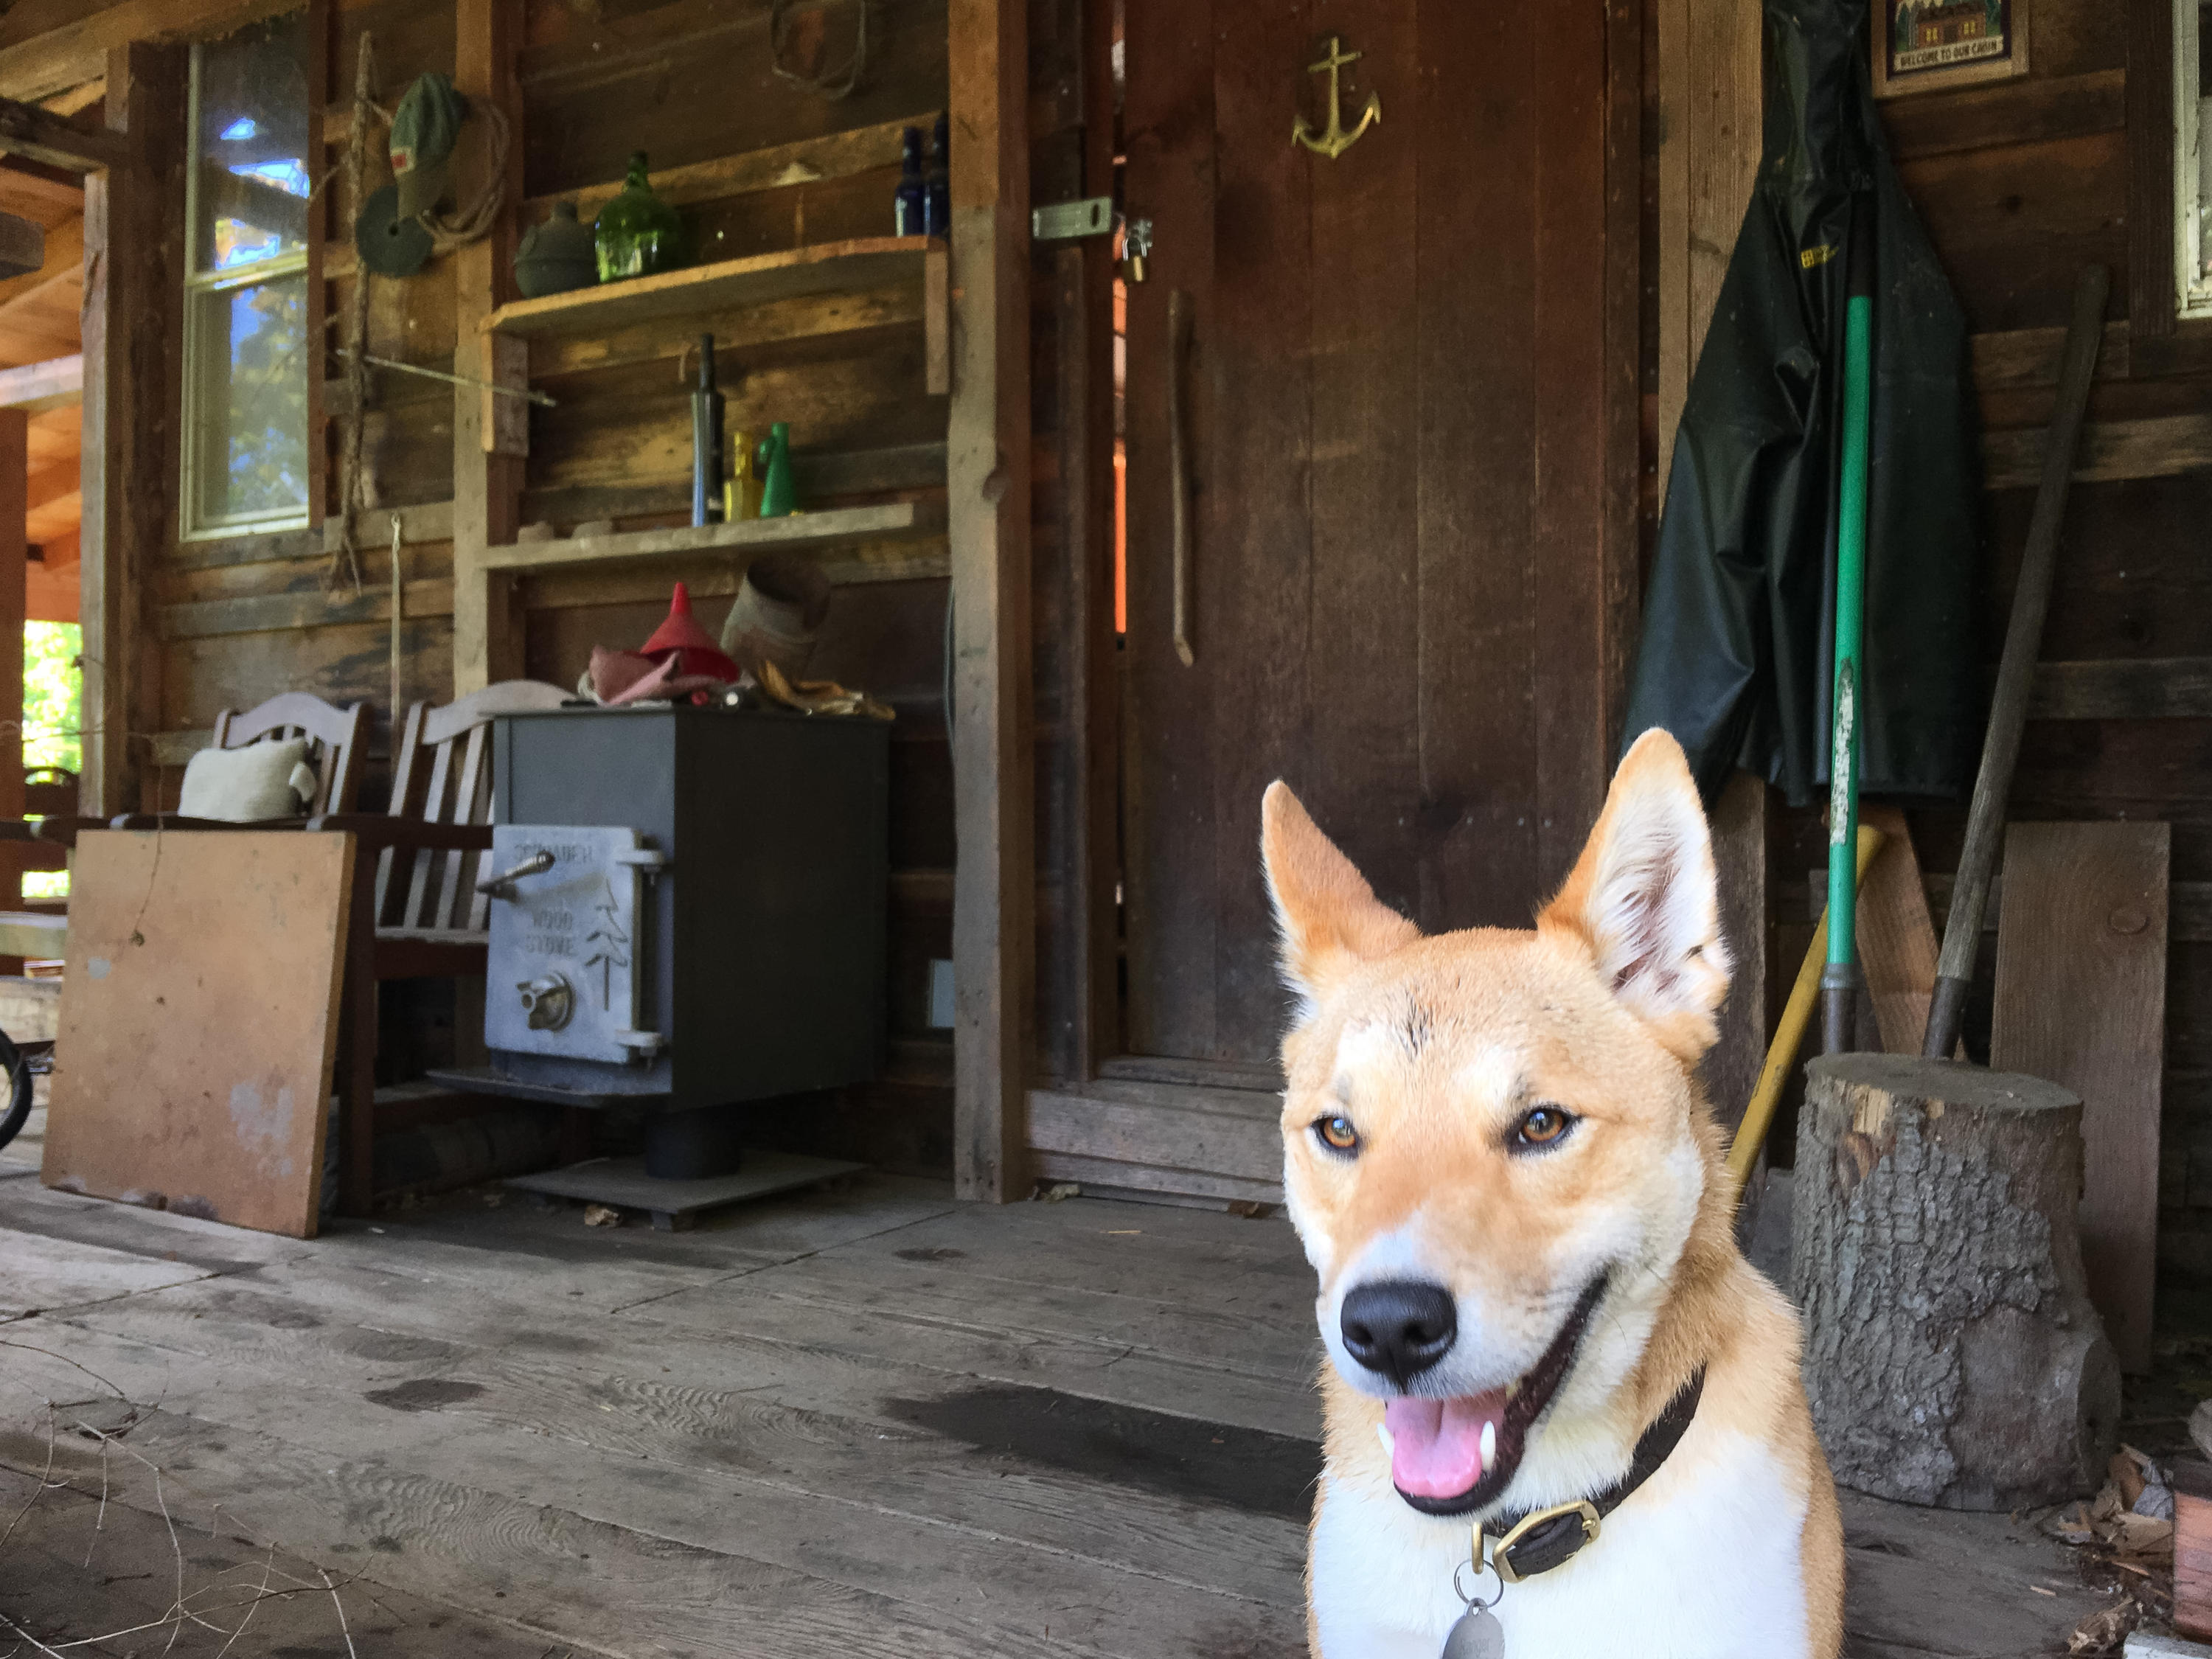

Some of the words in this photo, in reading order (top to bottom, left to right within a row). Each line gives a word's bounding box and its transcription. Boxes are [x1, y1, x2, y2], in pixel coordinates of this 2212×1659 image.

[1900, 51, 1938, 67] WELCOME
[1941, 48, 1952, 60] TO
[1953, 45, 1969, 58] OUR
[1972, 41, 1997, 55] CABIN
